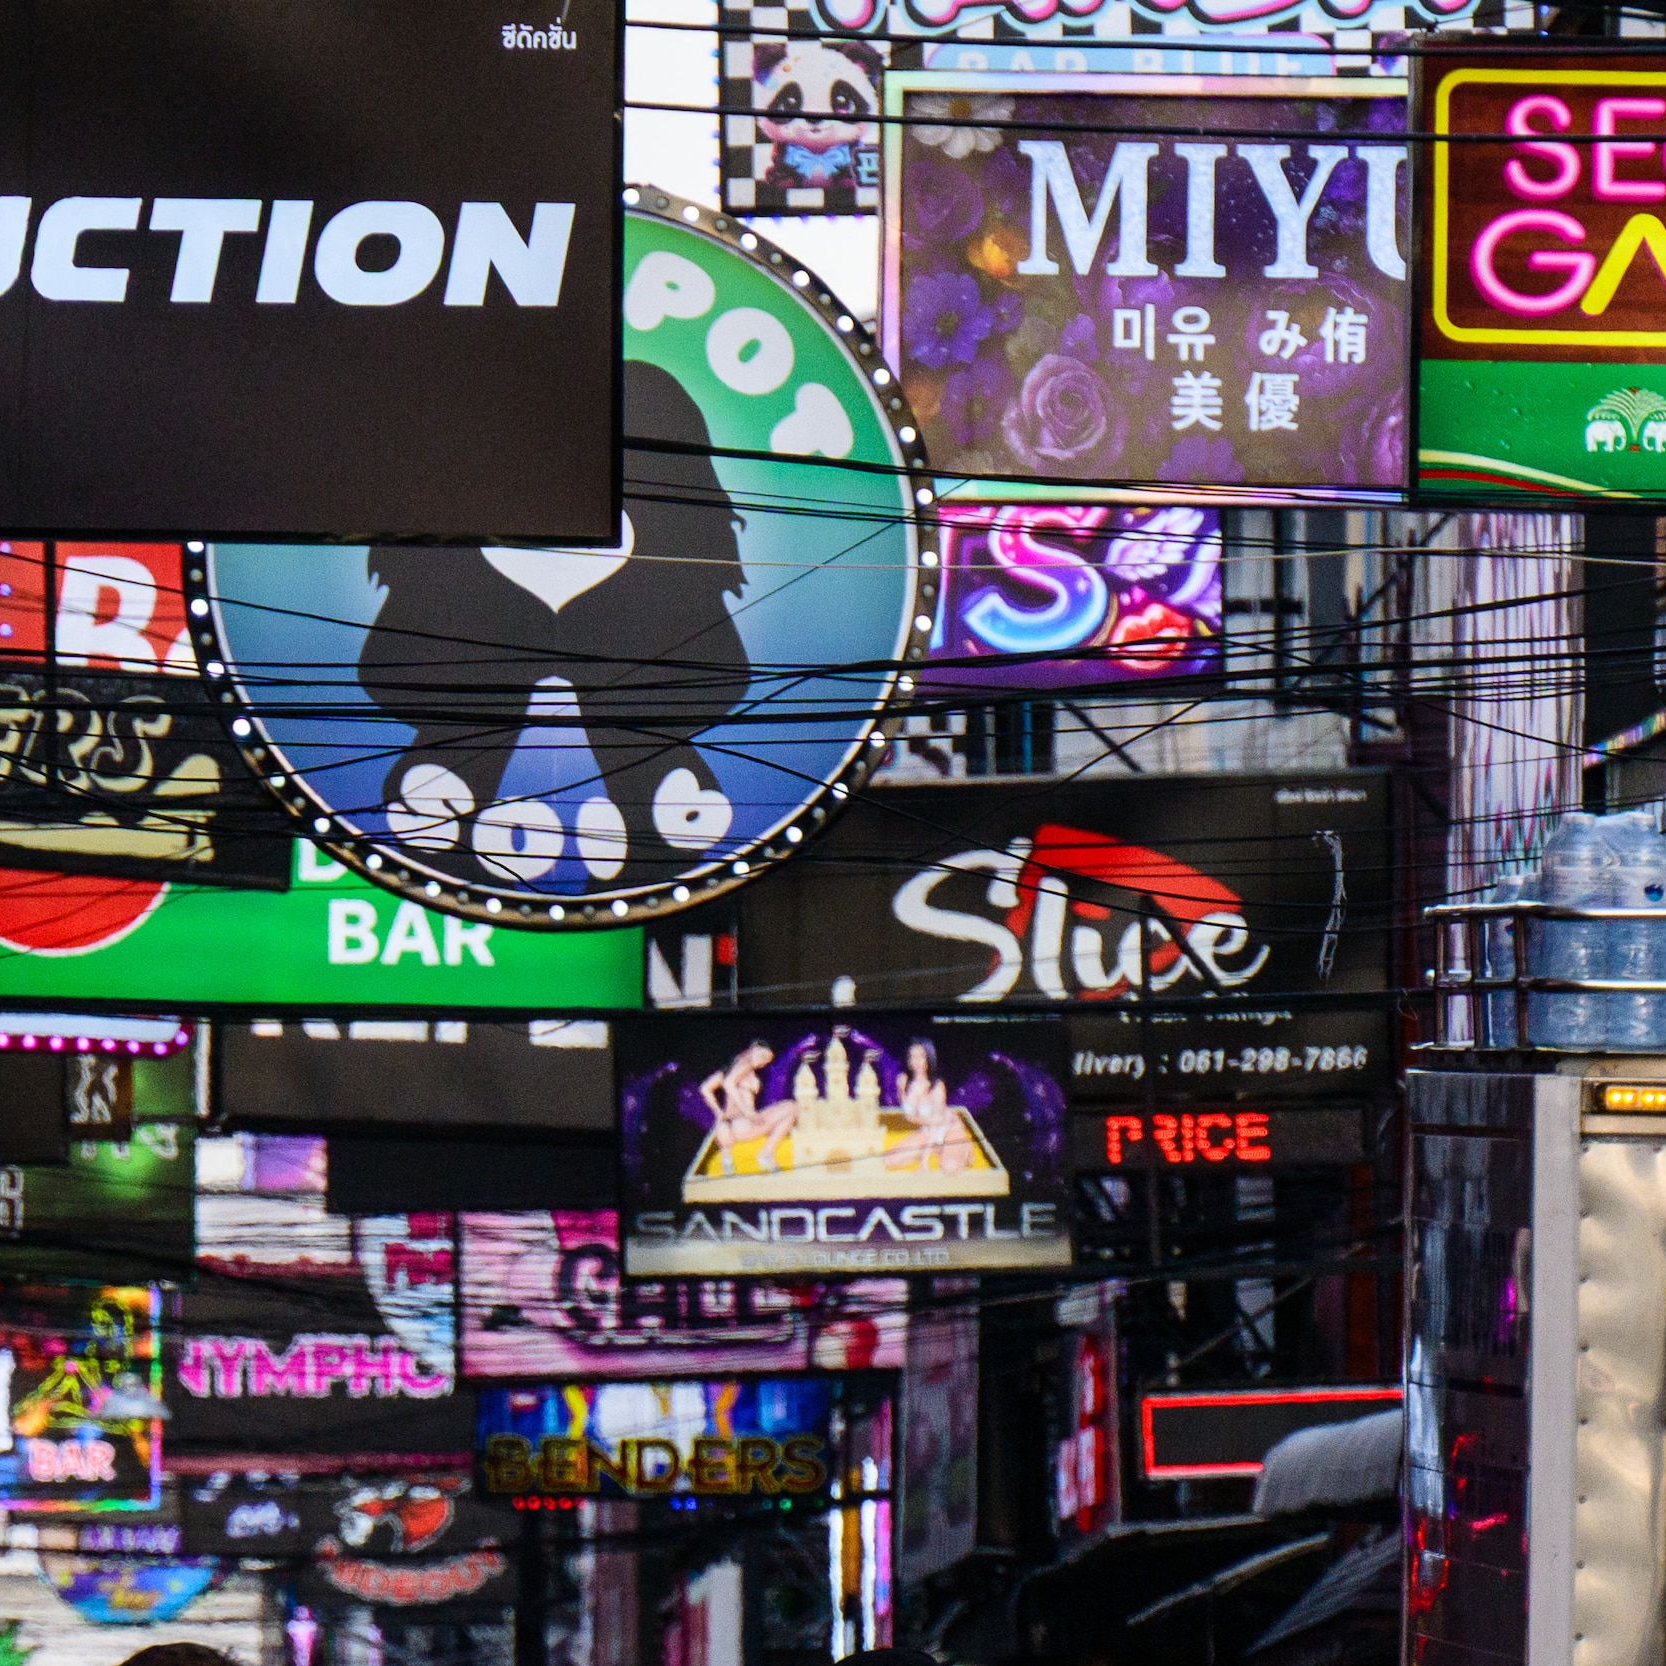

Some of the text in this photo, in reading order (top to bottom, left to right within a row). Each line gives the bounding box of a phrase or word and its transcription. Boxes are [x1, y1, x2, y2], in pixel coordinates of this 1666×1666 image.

[1112, 303, 1217, 363] 미유
[385, 763, 629, 881] SOI
[652, 766, 733, 850] 6
[328, 899, 496, 967] BAR
[1106, 1113, 1272, 1165] PRICE
[635, 1201, 1057, 1248] SANDCASTLE
[28, 1439, 116, 1482] BAR
[486, 1433, 827, 1496] BENDERS
